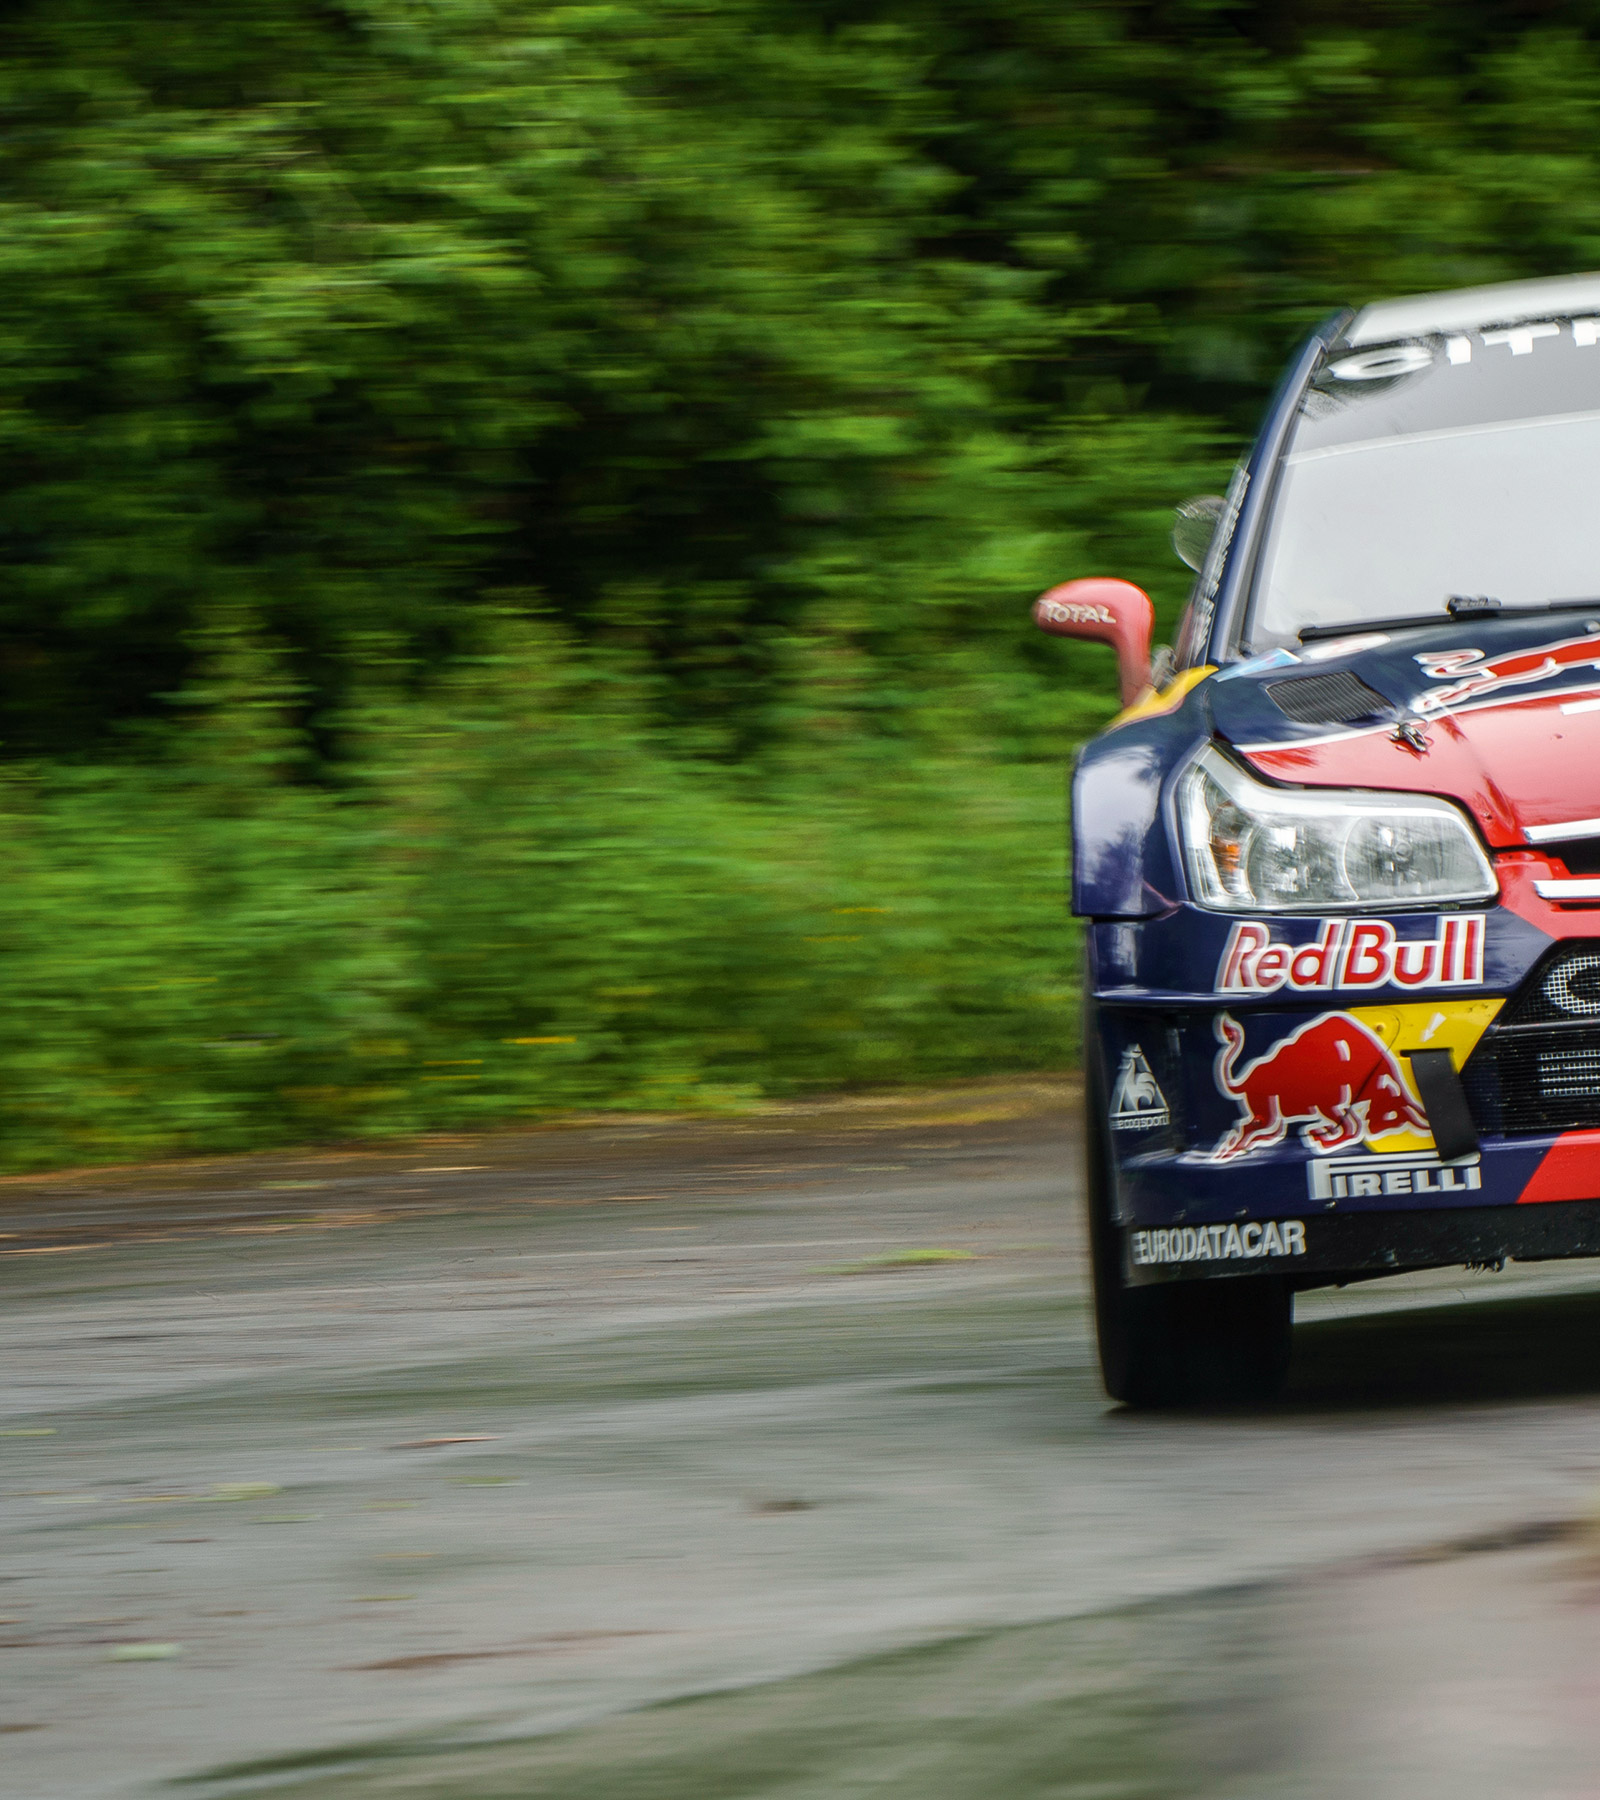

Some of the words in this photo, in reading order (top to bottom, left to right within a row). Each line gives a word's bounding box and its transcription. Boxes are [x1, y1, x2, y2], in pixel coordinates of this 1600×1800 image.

[1037, 598, 1117, 623] TOTAL
[1307, 1152, 1482, 1200] PIRELLI
[1134, 1219, 1307, 1265] EURODATACAR
